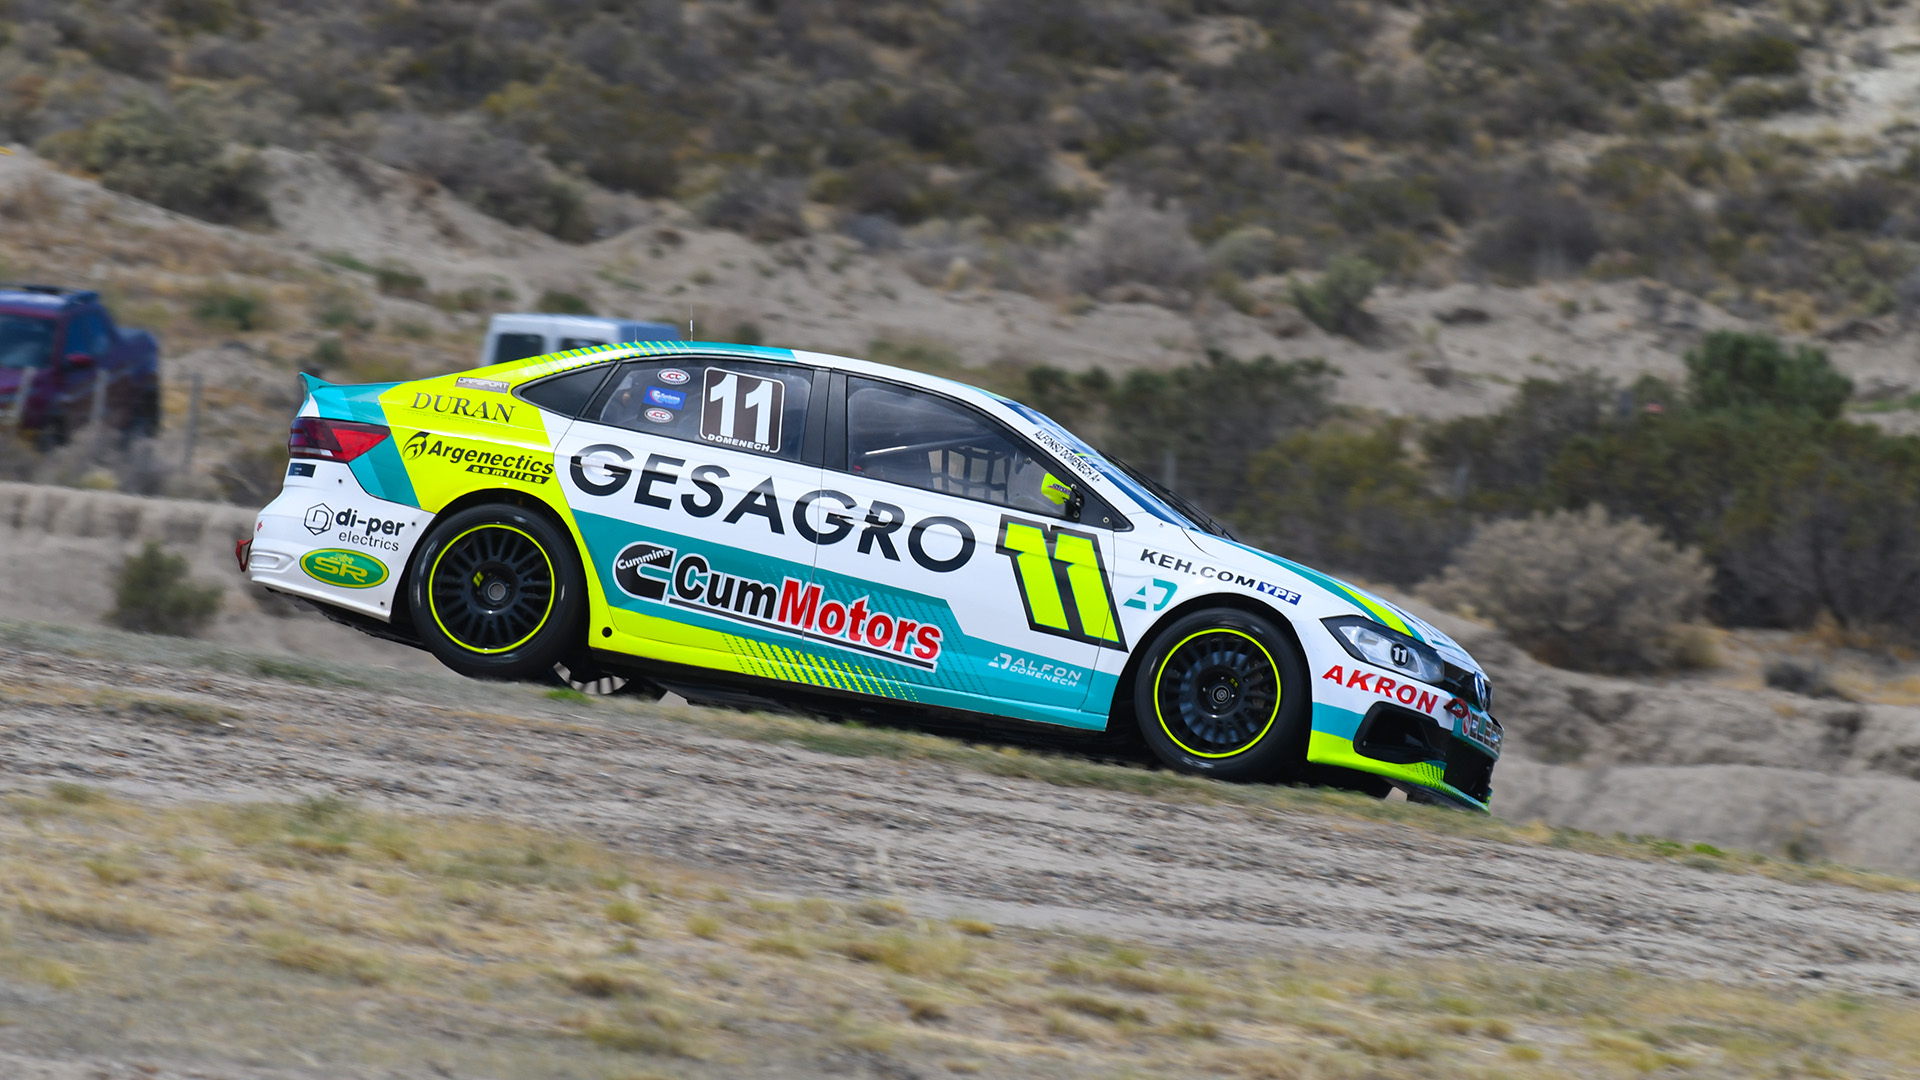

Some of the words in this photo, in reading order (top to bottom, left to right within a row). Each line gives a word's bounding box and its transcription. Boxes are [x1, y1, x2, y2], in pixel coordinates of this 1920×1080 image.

[411, 392, 516, 423] DURAN
[710, 373, 773, 445] 11
[707, 434, 771, 452] DOMENECH
[1033, 430, 1063, 453] ALFONSO
[1060, 449, 1094, 478] DOMENECH
[427, 440, 555, 475] Argenectics
[472, 465, 544, 484] semillas
[335, 508, 405, 536] di-per
[569, 443, 976, 573] GESAGRO
[338, 530, 400, 551] electrics
[313, 556, 368, 583] SR
[616, 549, 671, 570] Cummins
[1140, 548, 1256, 588] KEH.COM
[999, 516, 1126, 649] 11
[1262, 583, 1299, 603] YPF
[672, 554, 943, 661] CumMotors
[1013, 657, 1082, 681] ALFON
[1392, 646, 1408, 664] 11
[1009, 665, 1078, 687] DOMENECH
[1322, 664, 1439, 714] AKRON
